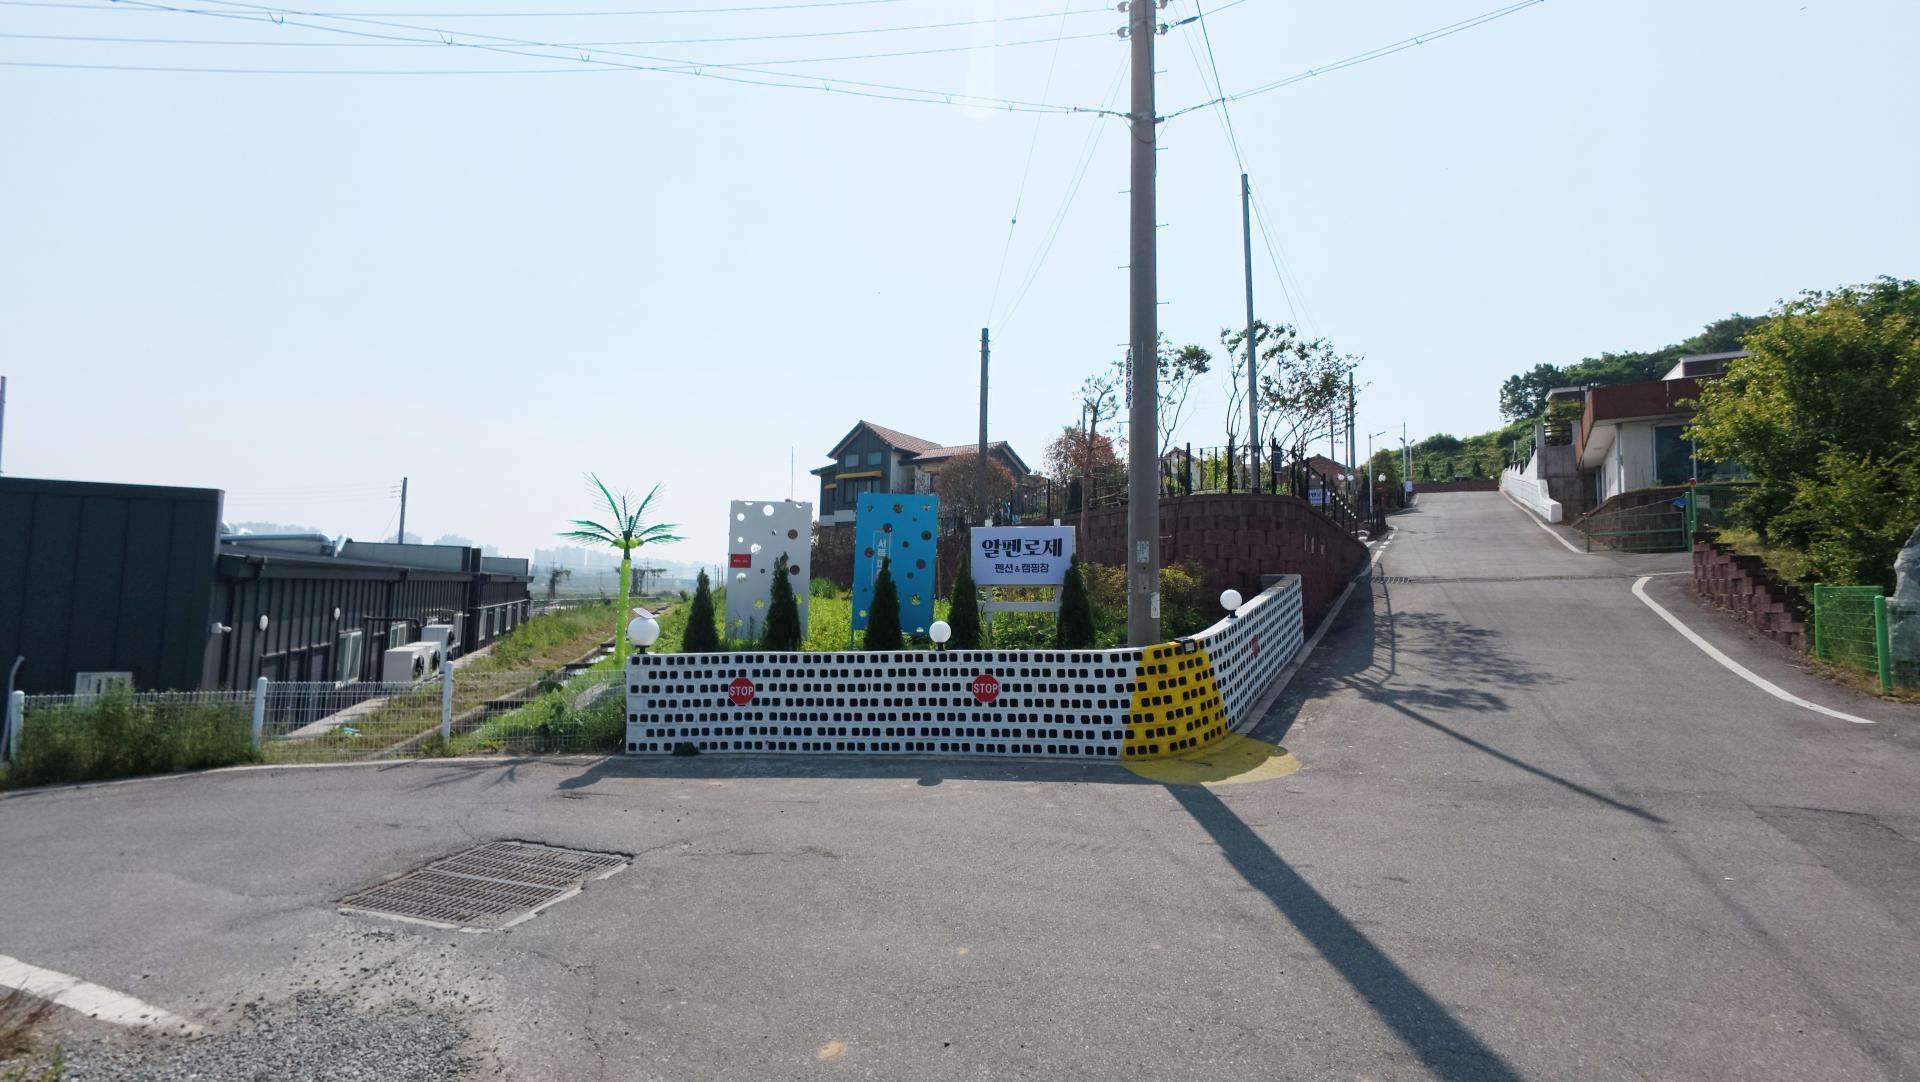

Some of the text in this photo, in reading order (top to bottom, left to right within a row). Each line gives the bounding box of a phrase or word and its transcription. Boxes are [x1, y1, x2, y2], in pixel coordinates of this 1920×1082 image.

[982, 538, 1063, 559] 알펜로제
[995, 563, 1014, 574] 펜션
[1022, 563, 1050, 574] 캠핑장
[729, 686, 754, 697] STOP
[973, 683, 998, 694] STOP
